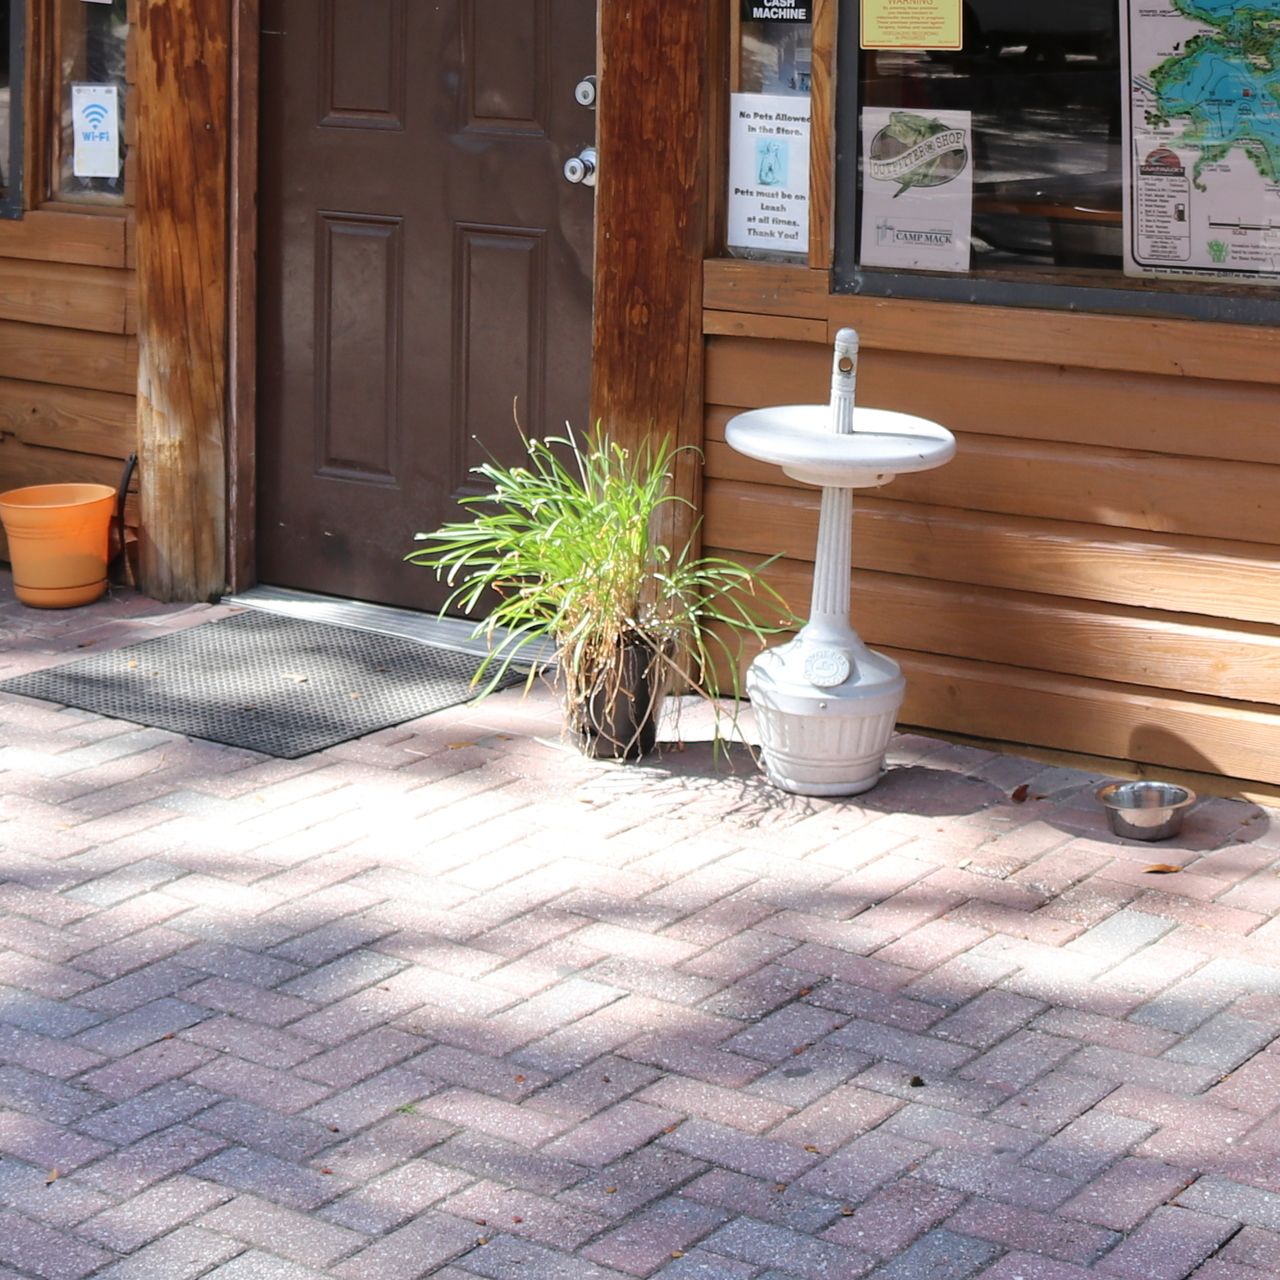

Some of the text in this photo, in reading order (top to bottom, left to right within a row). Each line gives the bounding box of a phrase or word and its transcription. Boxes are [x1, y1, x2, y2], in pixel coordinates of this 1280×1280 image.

[752, 7, 807, 20] MACHINE
[739, 111, 751, 119] No
[753, 112, 773, 120] Pets
[759, 125, 774, 133] the
[776, 127, 803, 136] Store.
[81, 131, 110, 142] Wi-Fi
[872, 131, 963, 176] OUTFITTER SHOP
[734, 188, 754, 197] Pets
[756, 190, 779, 198] must
[781, 190, 793, 199] be
[760, 203, 787, 213] Leash
[758, 216, 770, 224] all
[772, 217, 800, 227] times.
[747, 228, 799, 241] Thank You!
[895, 232, 953, 244] CAMP MACK
